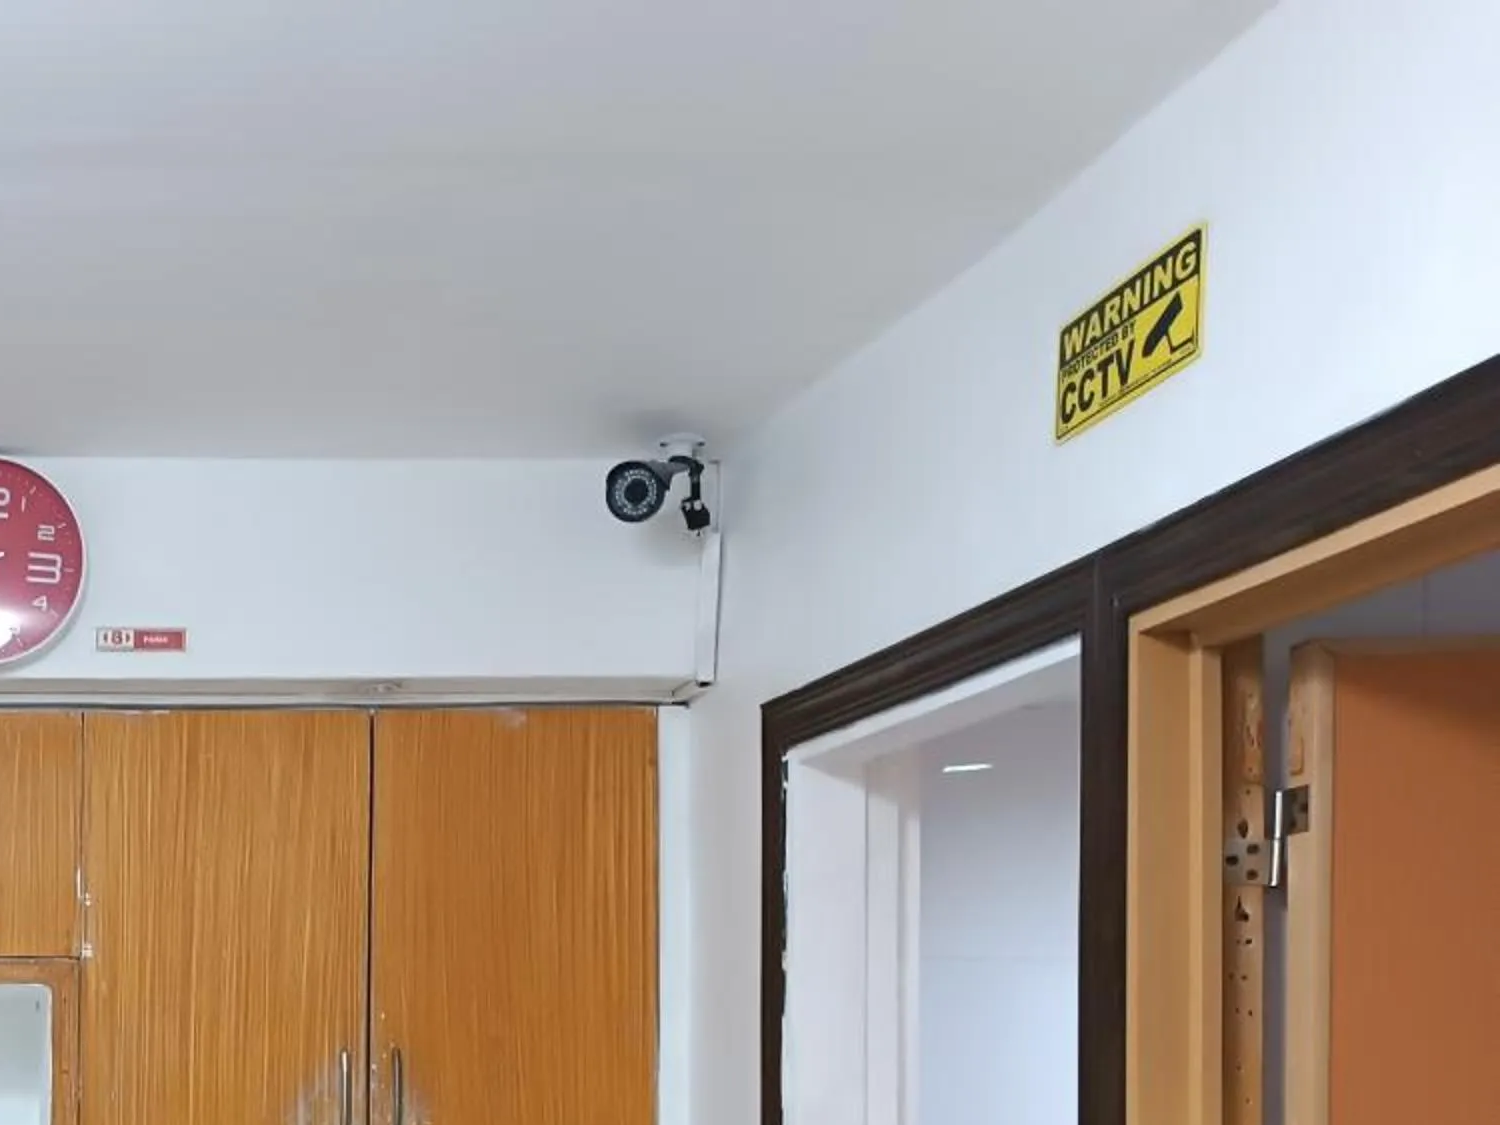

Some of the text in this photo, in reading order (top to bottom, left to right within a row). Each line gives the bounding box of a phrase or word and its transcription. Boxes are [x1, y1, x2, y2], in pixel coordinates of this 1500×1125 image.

[1062, 240, 1197, 362] WARNING
[1060, 338, 1135, 424] CCTV
[37, 524, 55, 541] 2
[25, 551, 62, 584] 3
[31, 595, 47, 611] 4
